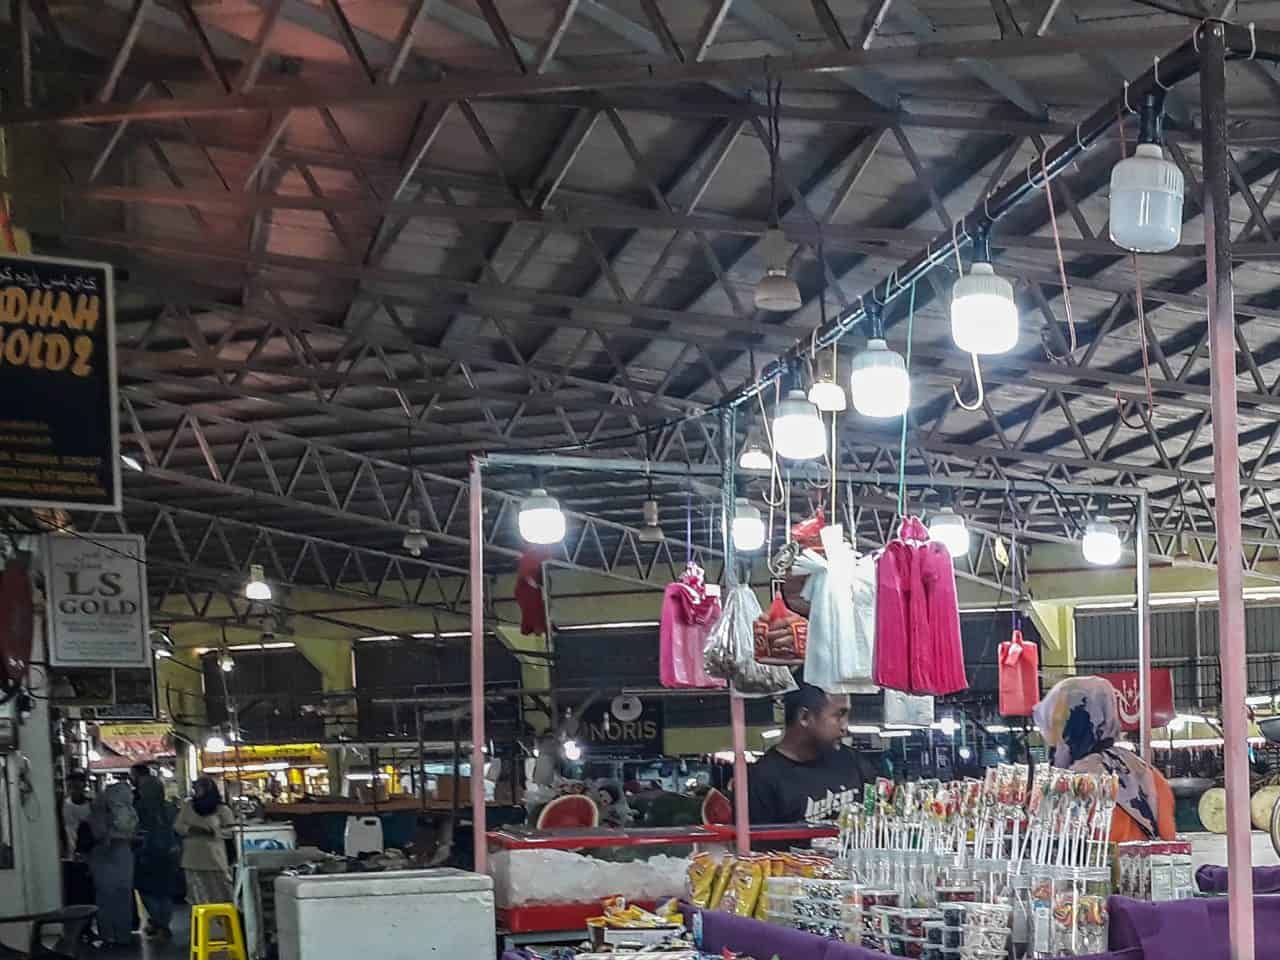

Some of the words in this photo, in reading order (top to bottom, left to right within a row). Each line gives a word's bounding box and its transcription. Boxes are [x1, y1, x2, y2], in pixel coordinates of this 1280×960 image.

[0, 287, 99, 331] DHAH
[64, 571, 123, 597] LS
[59, 600, 136, 615] GOLD
